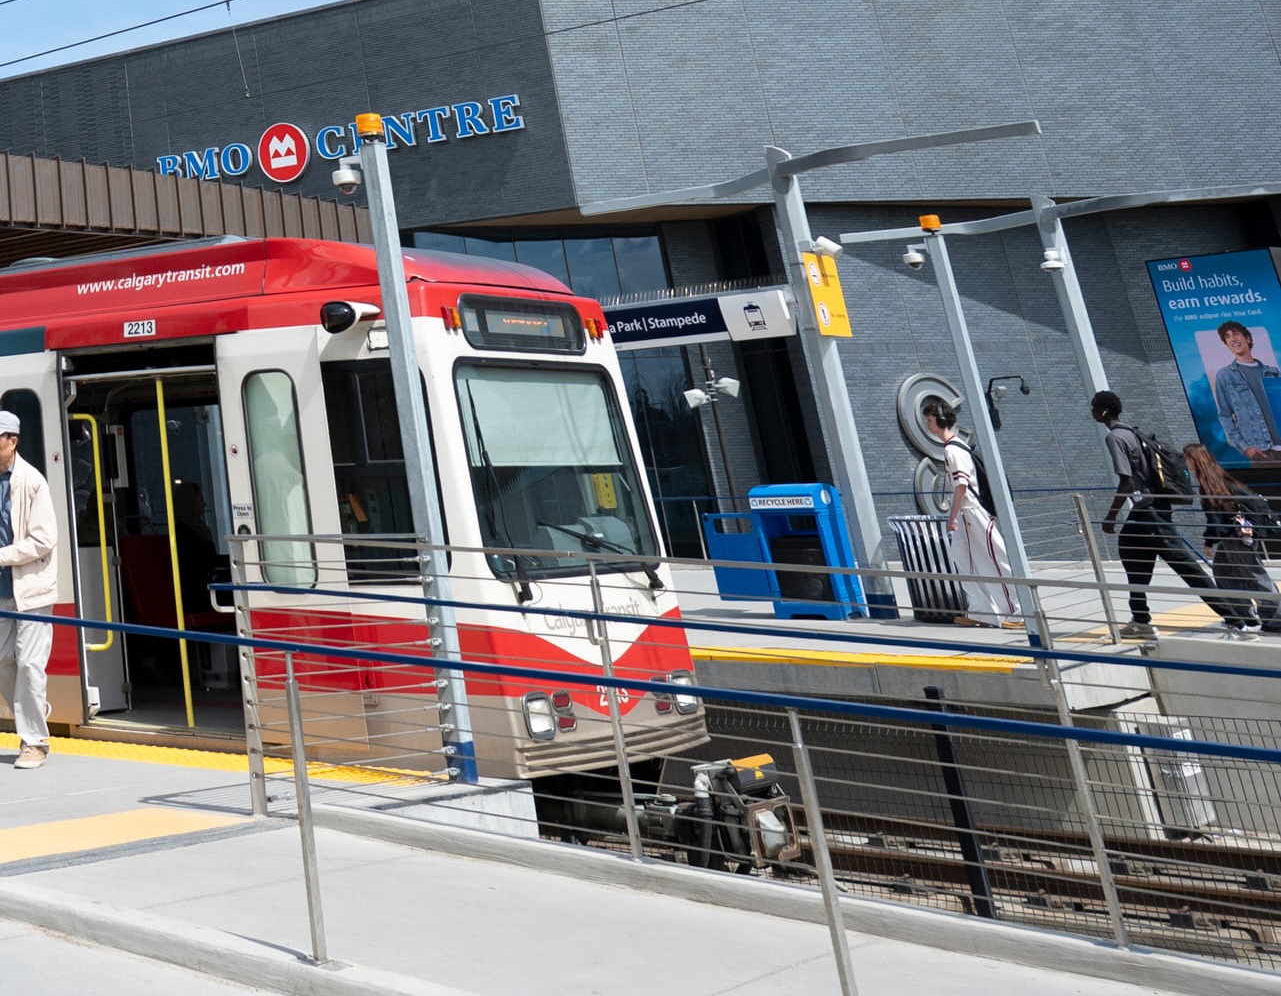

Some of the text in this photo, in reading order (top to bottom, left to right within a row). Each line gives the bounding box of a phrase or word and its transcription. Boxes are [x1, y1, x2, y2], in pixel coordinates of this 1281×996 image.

[157, 142, 252, 181] BMO
[1157, 263, 1177, 272] BMO
[77, 262, 245, 295] www.calgarytransit.com
[1162, 273, 1243, 293] Build habits,
[1168, 289, 1267, 310] earn rewards.
[127, 321, 153, 335] 2213
[616, 320, 641, 333] Park
[648, 312, 707, 330] Stampede
[758, 498, 786, 507] RECYCLE
